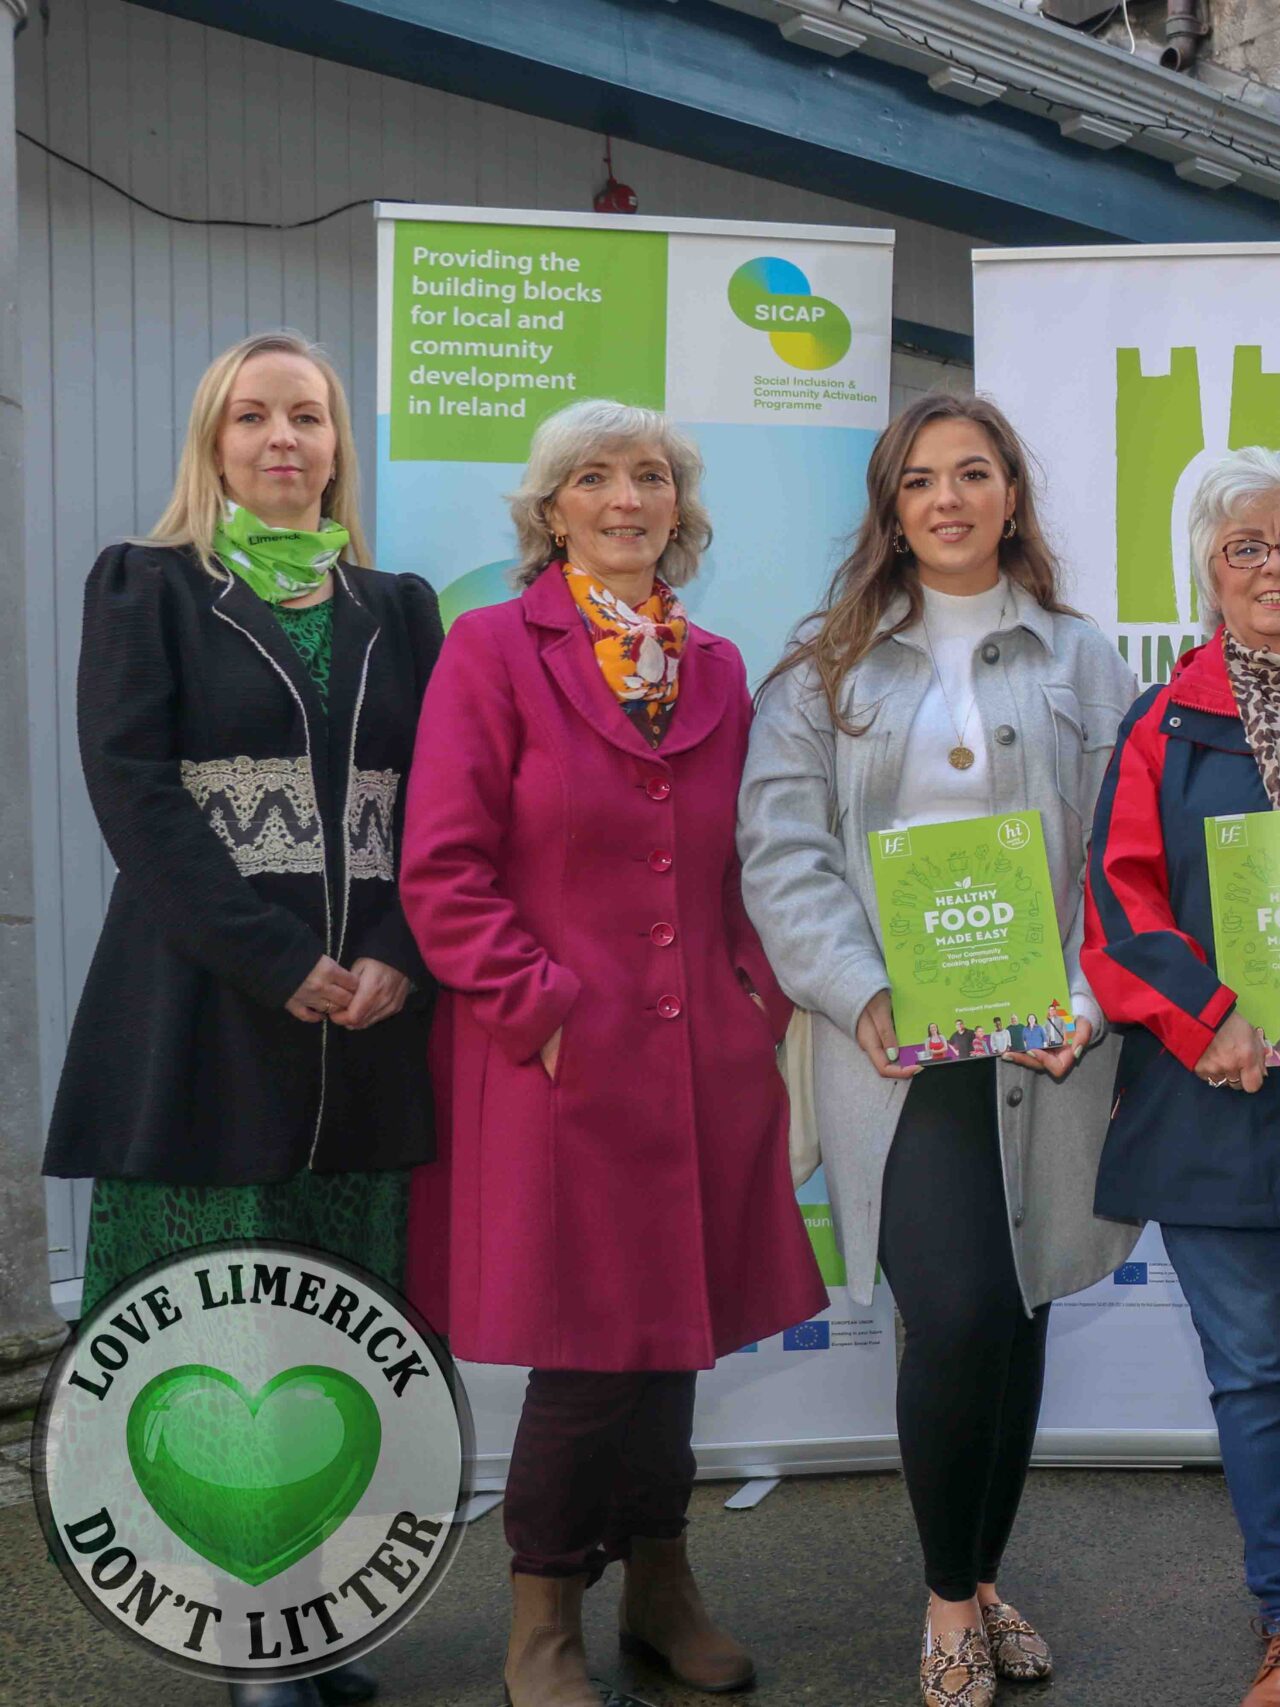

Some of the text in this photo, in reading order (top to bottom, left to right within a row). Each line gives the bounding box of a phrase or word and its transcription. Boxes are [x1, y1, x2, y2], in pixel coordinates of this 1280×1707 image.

[413, 246, 580, 275] Providing the
[412, 275, 602, 304] building blocks
[411, 305, 564, 330] for local and
[755, 304, 826, 323] SICAP
[410, 339, 553, 364] community
[409, 365, 576, 392] development
[754, 376, 856, 389] Social Inclusion &
[753, 387, 878, 403] Community Activation
[409, 395, 526, 418] in Ireland
[753, 399, 822, 411] Programme
[248, 533, 302, 546] Limerick
[1004, 822, 1023, 839] hi
[935, 889, 997, 907] HEALTHY
[924, 902, 1015, 934] FOOD
[935, 927, 1008, 946] MADE EASY
[942, 955, 1009, 968] Cooking Programme
[964, 947, 1001, 958] Community
